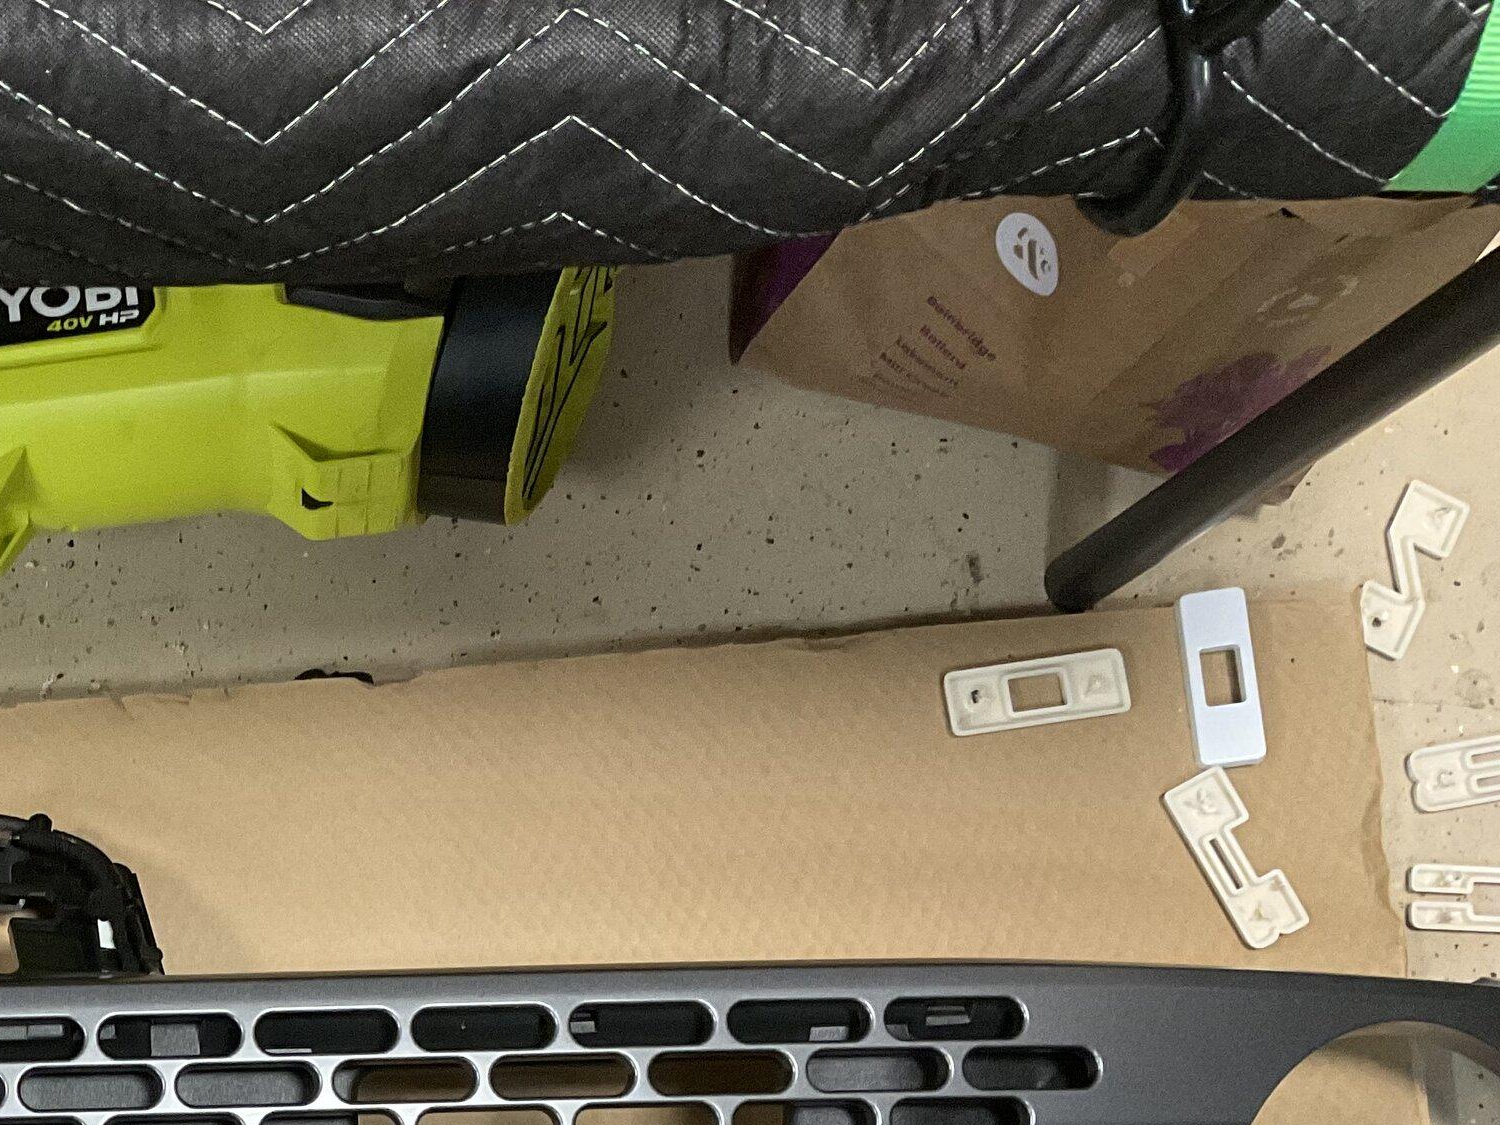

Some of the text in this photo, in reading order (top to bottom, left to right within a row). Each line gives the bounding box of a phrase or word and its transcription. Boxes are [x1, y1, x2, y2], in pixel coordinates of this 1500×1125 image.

[47, 309, 140, 332] 40V HP
[927, 295, 997, 362] Bainbridge
